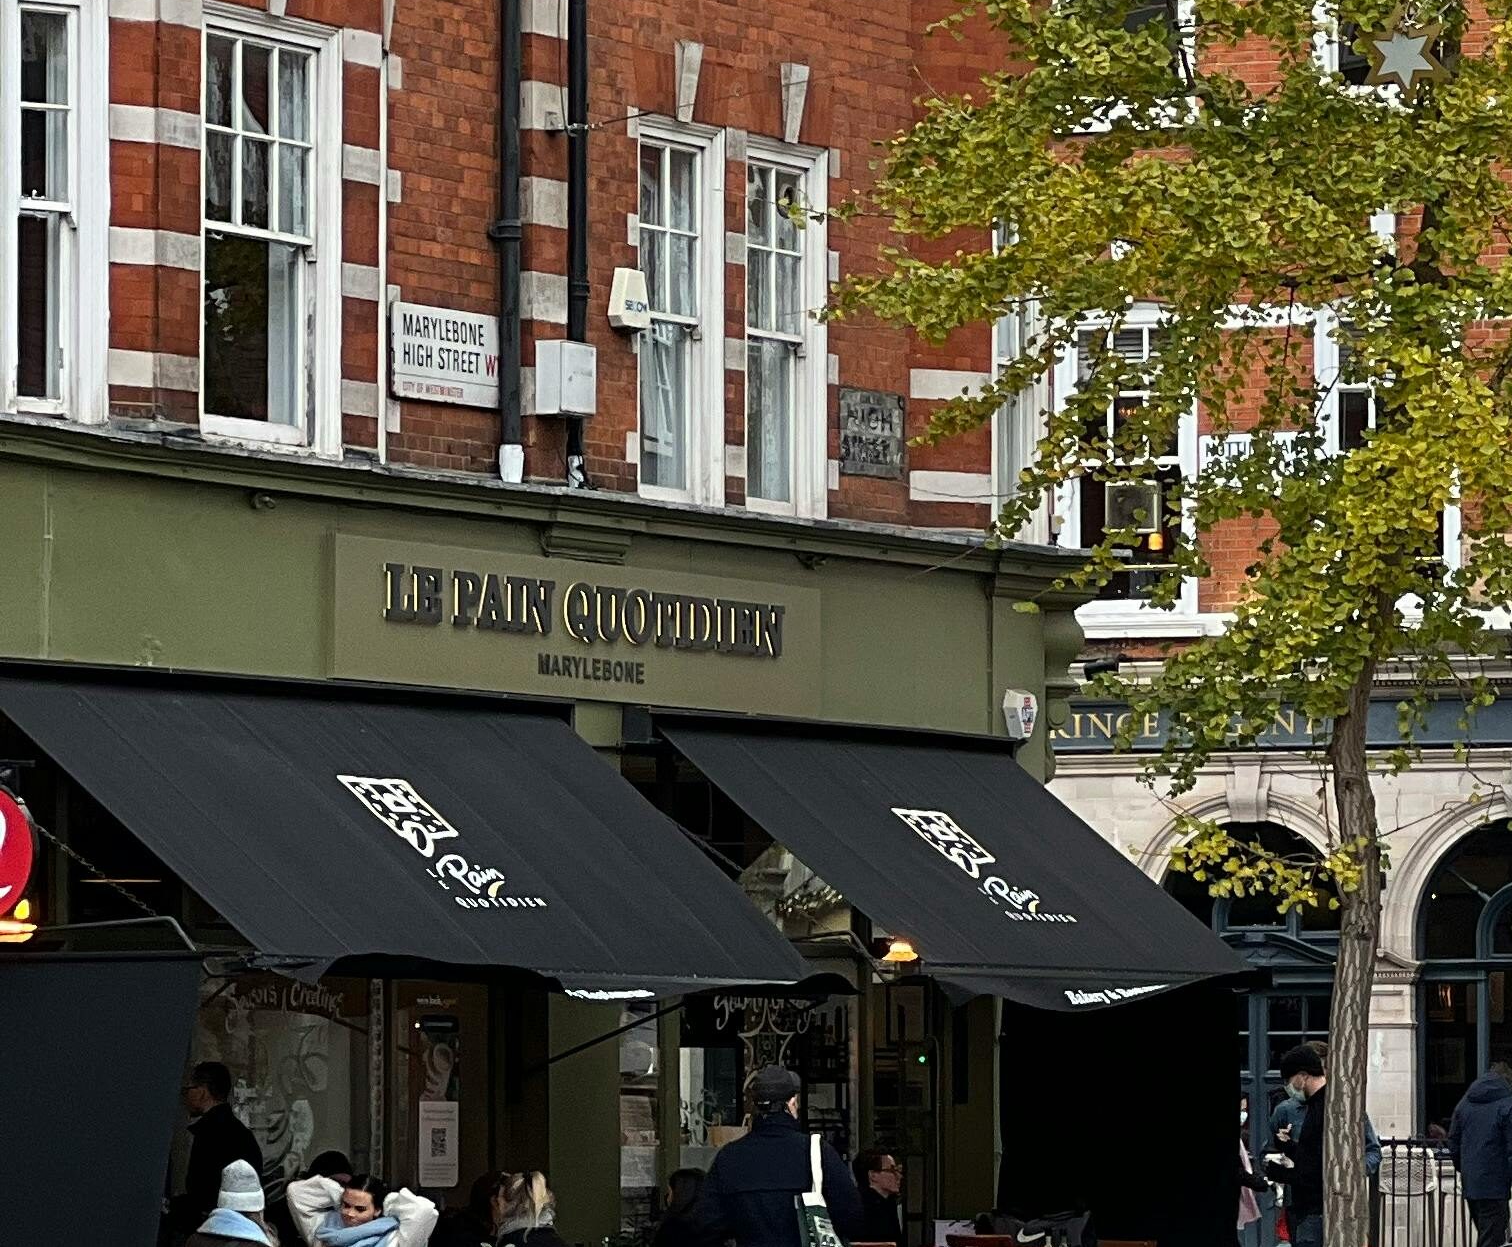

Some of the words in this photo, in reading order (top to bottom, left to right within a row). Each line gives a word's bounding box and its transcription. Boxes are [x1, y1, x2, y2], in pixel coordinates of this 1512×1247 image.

[403, 313, 485, 347] MARYLEBONE
[403, 342, 433, 368] HIGH
[438, 347, 481, 374] STREET
[383, 562, 443, 625] LE
[451, 569, 555, 635] PAIN
[563, 580, 786, 658] QUOTIDIEN
[537, 653, 646, 685] MARYLEBONE
[435, 854, 505, 894] Pain
[455, 896, 547, 909] QUOTIDIEN
[983, 876, 1040, 910] Pain
